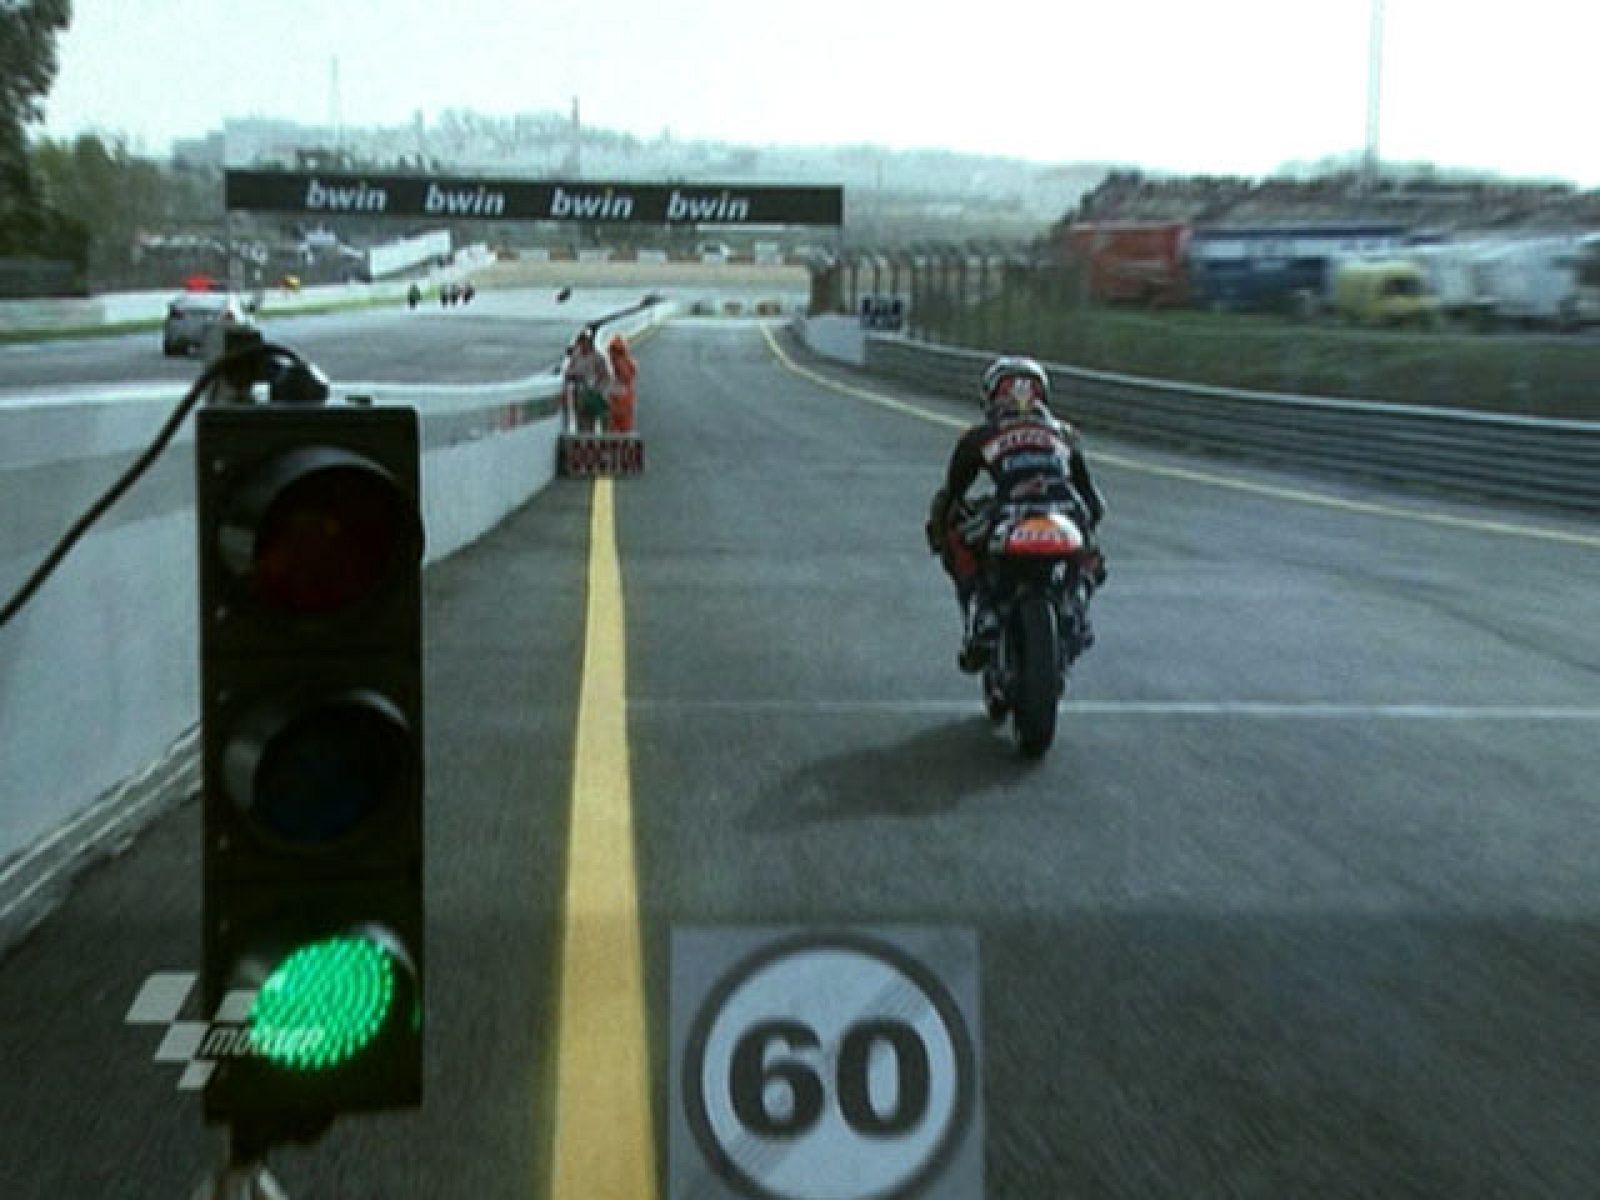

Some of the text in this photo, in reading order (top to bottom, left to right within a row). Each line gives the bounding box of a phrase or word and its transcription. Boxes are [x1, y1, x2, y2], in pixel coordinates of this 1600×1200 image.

[306, 179, 750, 221] bwin bwin bwin bwin
[729, 1015, 933, 1140] 60
